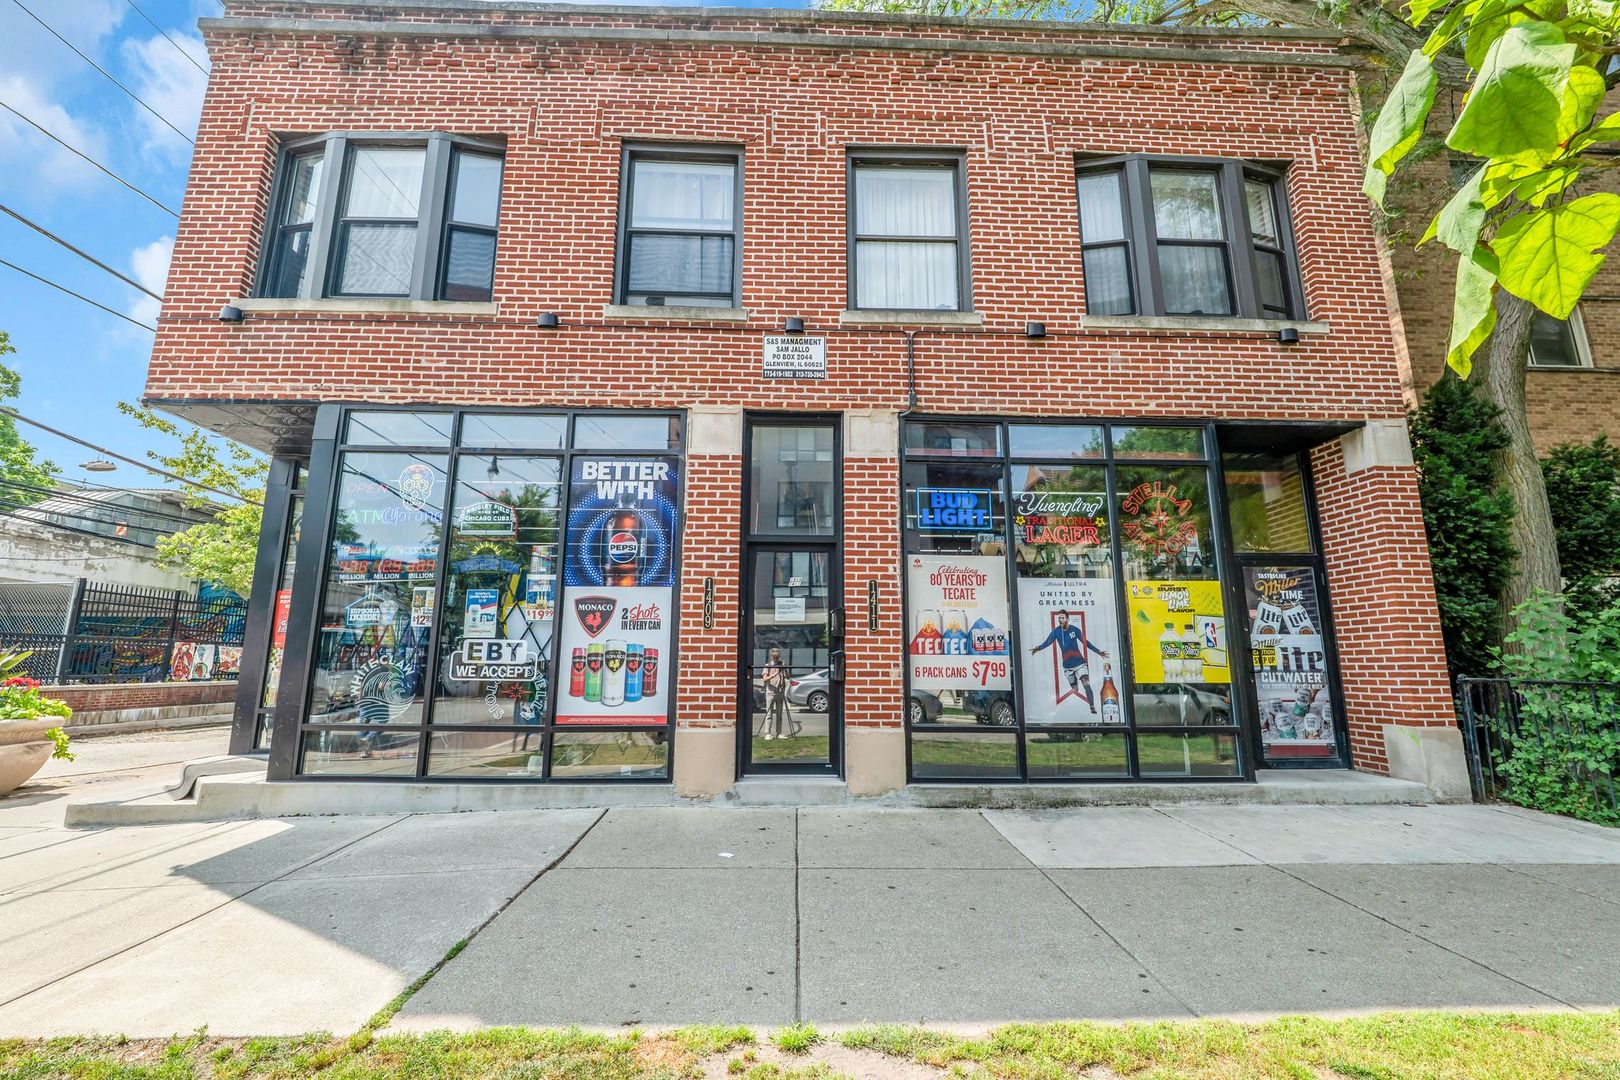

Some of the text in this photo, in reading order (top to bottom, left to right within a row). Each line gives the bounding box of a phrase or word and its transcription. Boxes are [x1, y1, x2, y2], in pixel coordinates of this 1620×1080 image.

[582, 462, 668, 480] BETTER
[347, 483, 388, 494] OPEN
[597, 481, 654, 500] WITH
[930, 492, 978, 508] BUD
[1018, 492, 1104, 517] Yuengling
[1122, 481, 1192, 516] STELLA
[382, 506, 442, 526] Corona
[466, 503, 510, 514] WRIGLEY FIELD
[346, 510, 384, 525] ATM
[1026, 516, 1095, 525] TRADITIONAL
[1026, 525, 1101, 544] LAGER
[1123, 522, 1196, 556] ARTOIS
[938, 565, 978, 577] Celebrating
[930, 574, 987, 586] 80 YEARS OF
[1255, 576, 1302, 597] Miller
[942, 588, 976, 600] TECATE
[1162, 591, 1189, 601] LEMON
[1280, 591, 1304, 599] TIME
[704, 578, 712, 628] 1409
[1168, 599, 1190, 609] LIME
[621, 608, 628, 620] 2
[1260, 608, 1282, 623] Lite
[1288, 610, 1308, 627] Lite
[621, 621, 661, 630] IN EVERY CAN
[1252, 638, 1283, 648] Miller
[468, 642, 523, 661] EBT
[379, 654, 414, 676] CLAW
[1272, 647, 1324, 672] ite
[350, 658, 379, 696] WHITE
[456, 666, 532, 677] WE ACCEPT
[915, 667, 920, 677] 6
[923, 667, 943, 678] PACK
[946, 667, 967, 678] CANS
[1261, 672, 1322, 683] CUTWATER
